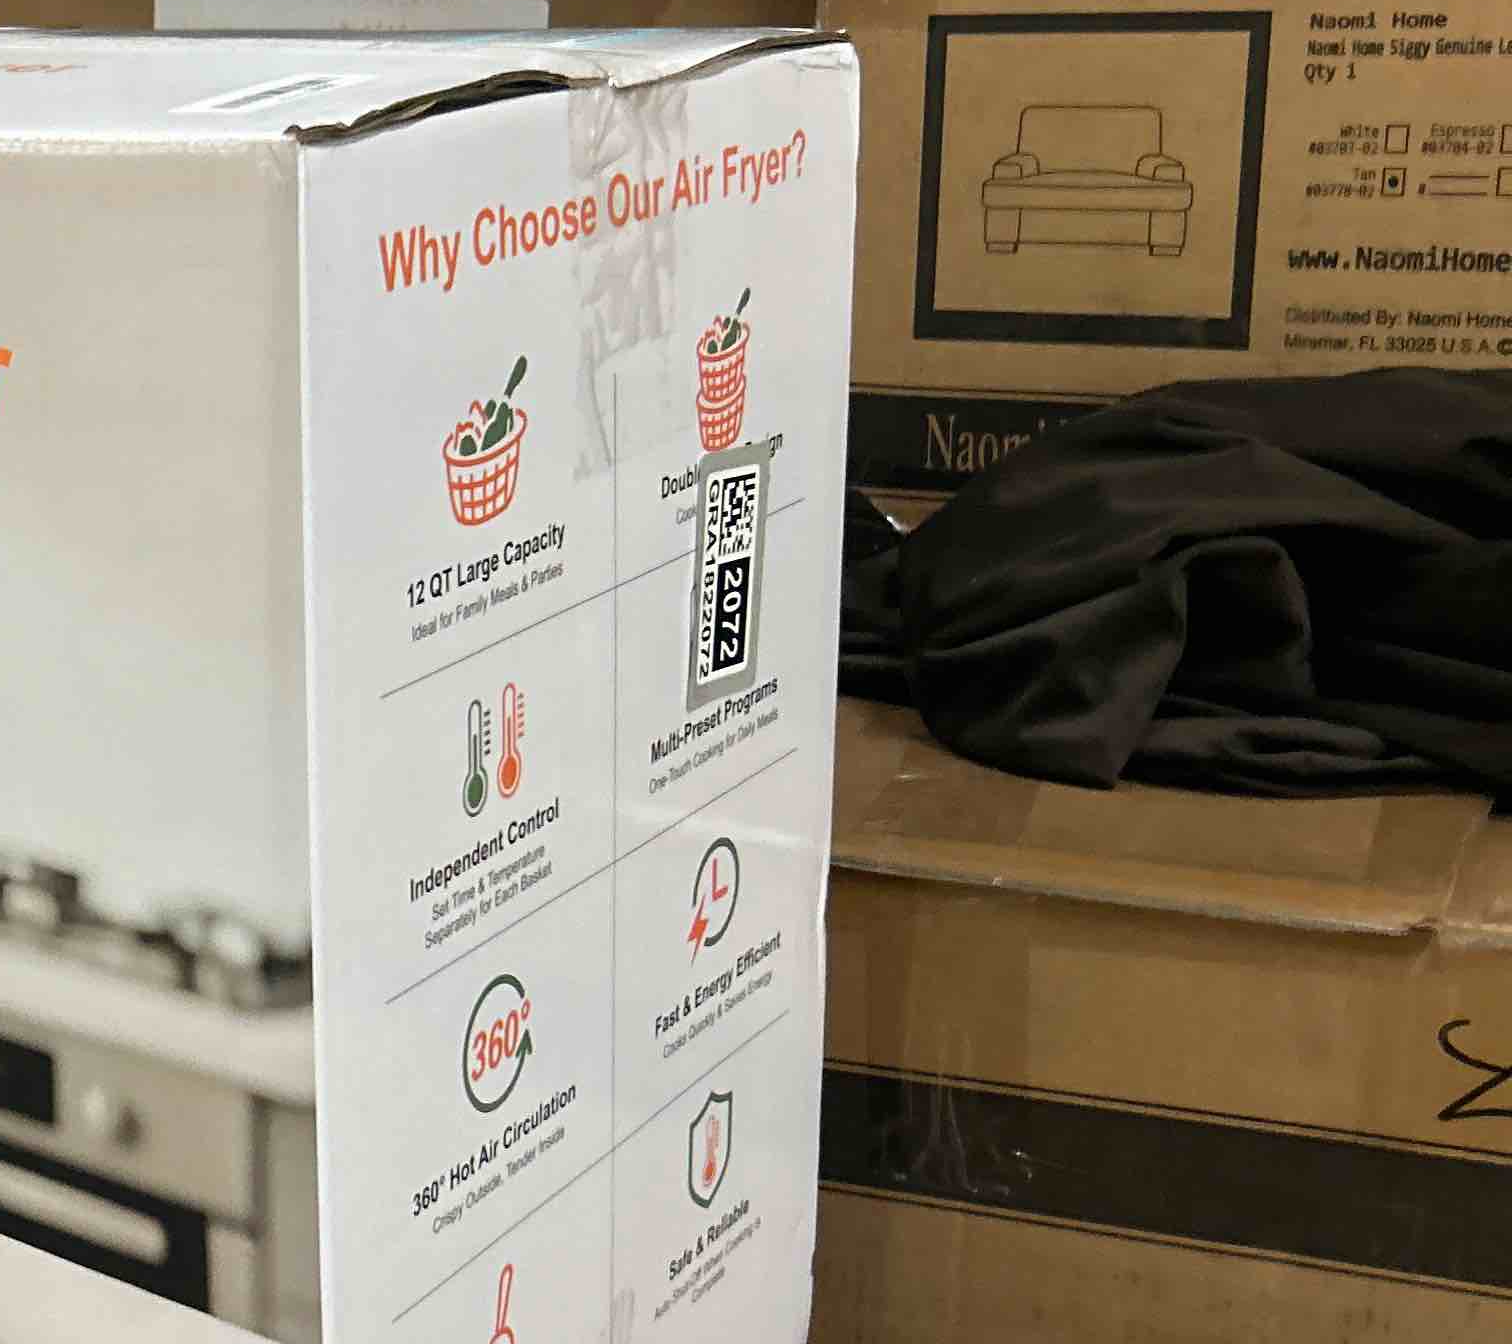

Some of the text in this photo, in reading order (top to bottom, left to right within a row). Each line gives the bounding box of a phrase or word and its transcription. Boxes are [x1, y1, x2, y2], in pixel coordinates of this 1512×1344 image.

[1307, 38, 1347, 56] Naomi
[1352, 40, 1384, 56] Home
[1390, 39, 1431, 60] Siggy
[1435, 36, 1492, 55] Genuine
[1310, 12, 1448, 30] Naomi Home
[1304, 62, 1356, 84] Qty 1
[1340, 123, 1495, 139] White Espresso
[1353, 168, 1376, 181] Tan
[379, 128, 807, 293] Why Choose Our Air Fryer?
[1284, 333, 1353, 351] Miramar,
[1384, 337, 1436, 353] 33025
[1285, 307, 1370, 325] Distributed
[1407, 311, 1460, 327] Naomi
[924, 413, 1045, 472] Nao
[661, 462, 701, 498] Doubl
[407, 522, 565, 608] 12 QT Large Capacity
[699, 479, 720, 679] GRA1822072
[456, 591, 488, 624] Family
[720, 567, 743, 662] 2072
[651, 678, 778, 764] Multi-Preset Programs
[410, 797, 559, 903] Independent Control
[655, 931, 781, 1039] Fast & Energy Efficient
[471, 998, 531, 1082] 360°
[413, 1084, 576, 1217] 360° Hot Air Circulation
[669, 1199, 749, 1281] Safe & Reliable
